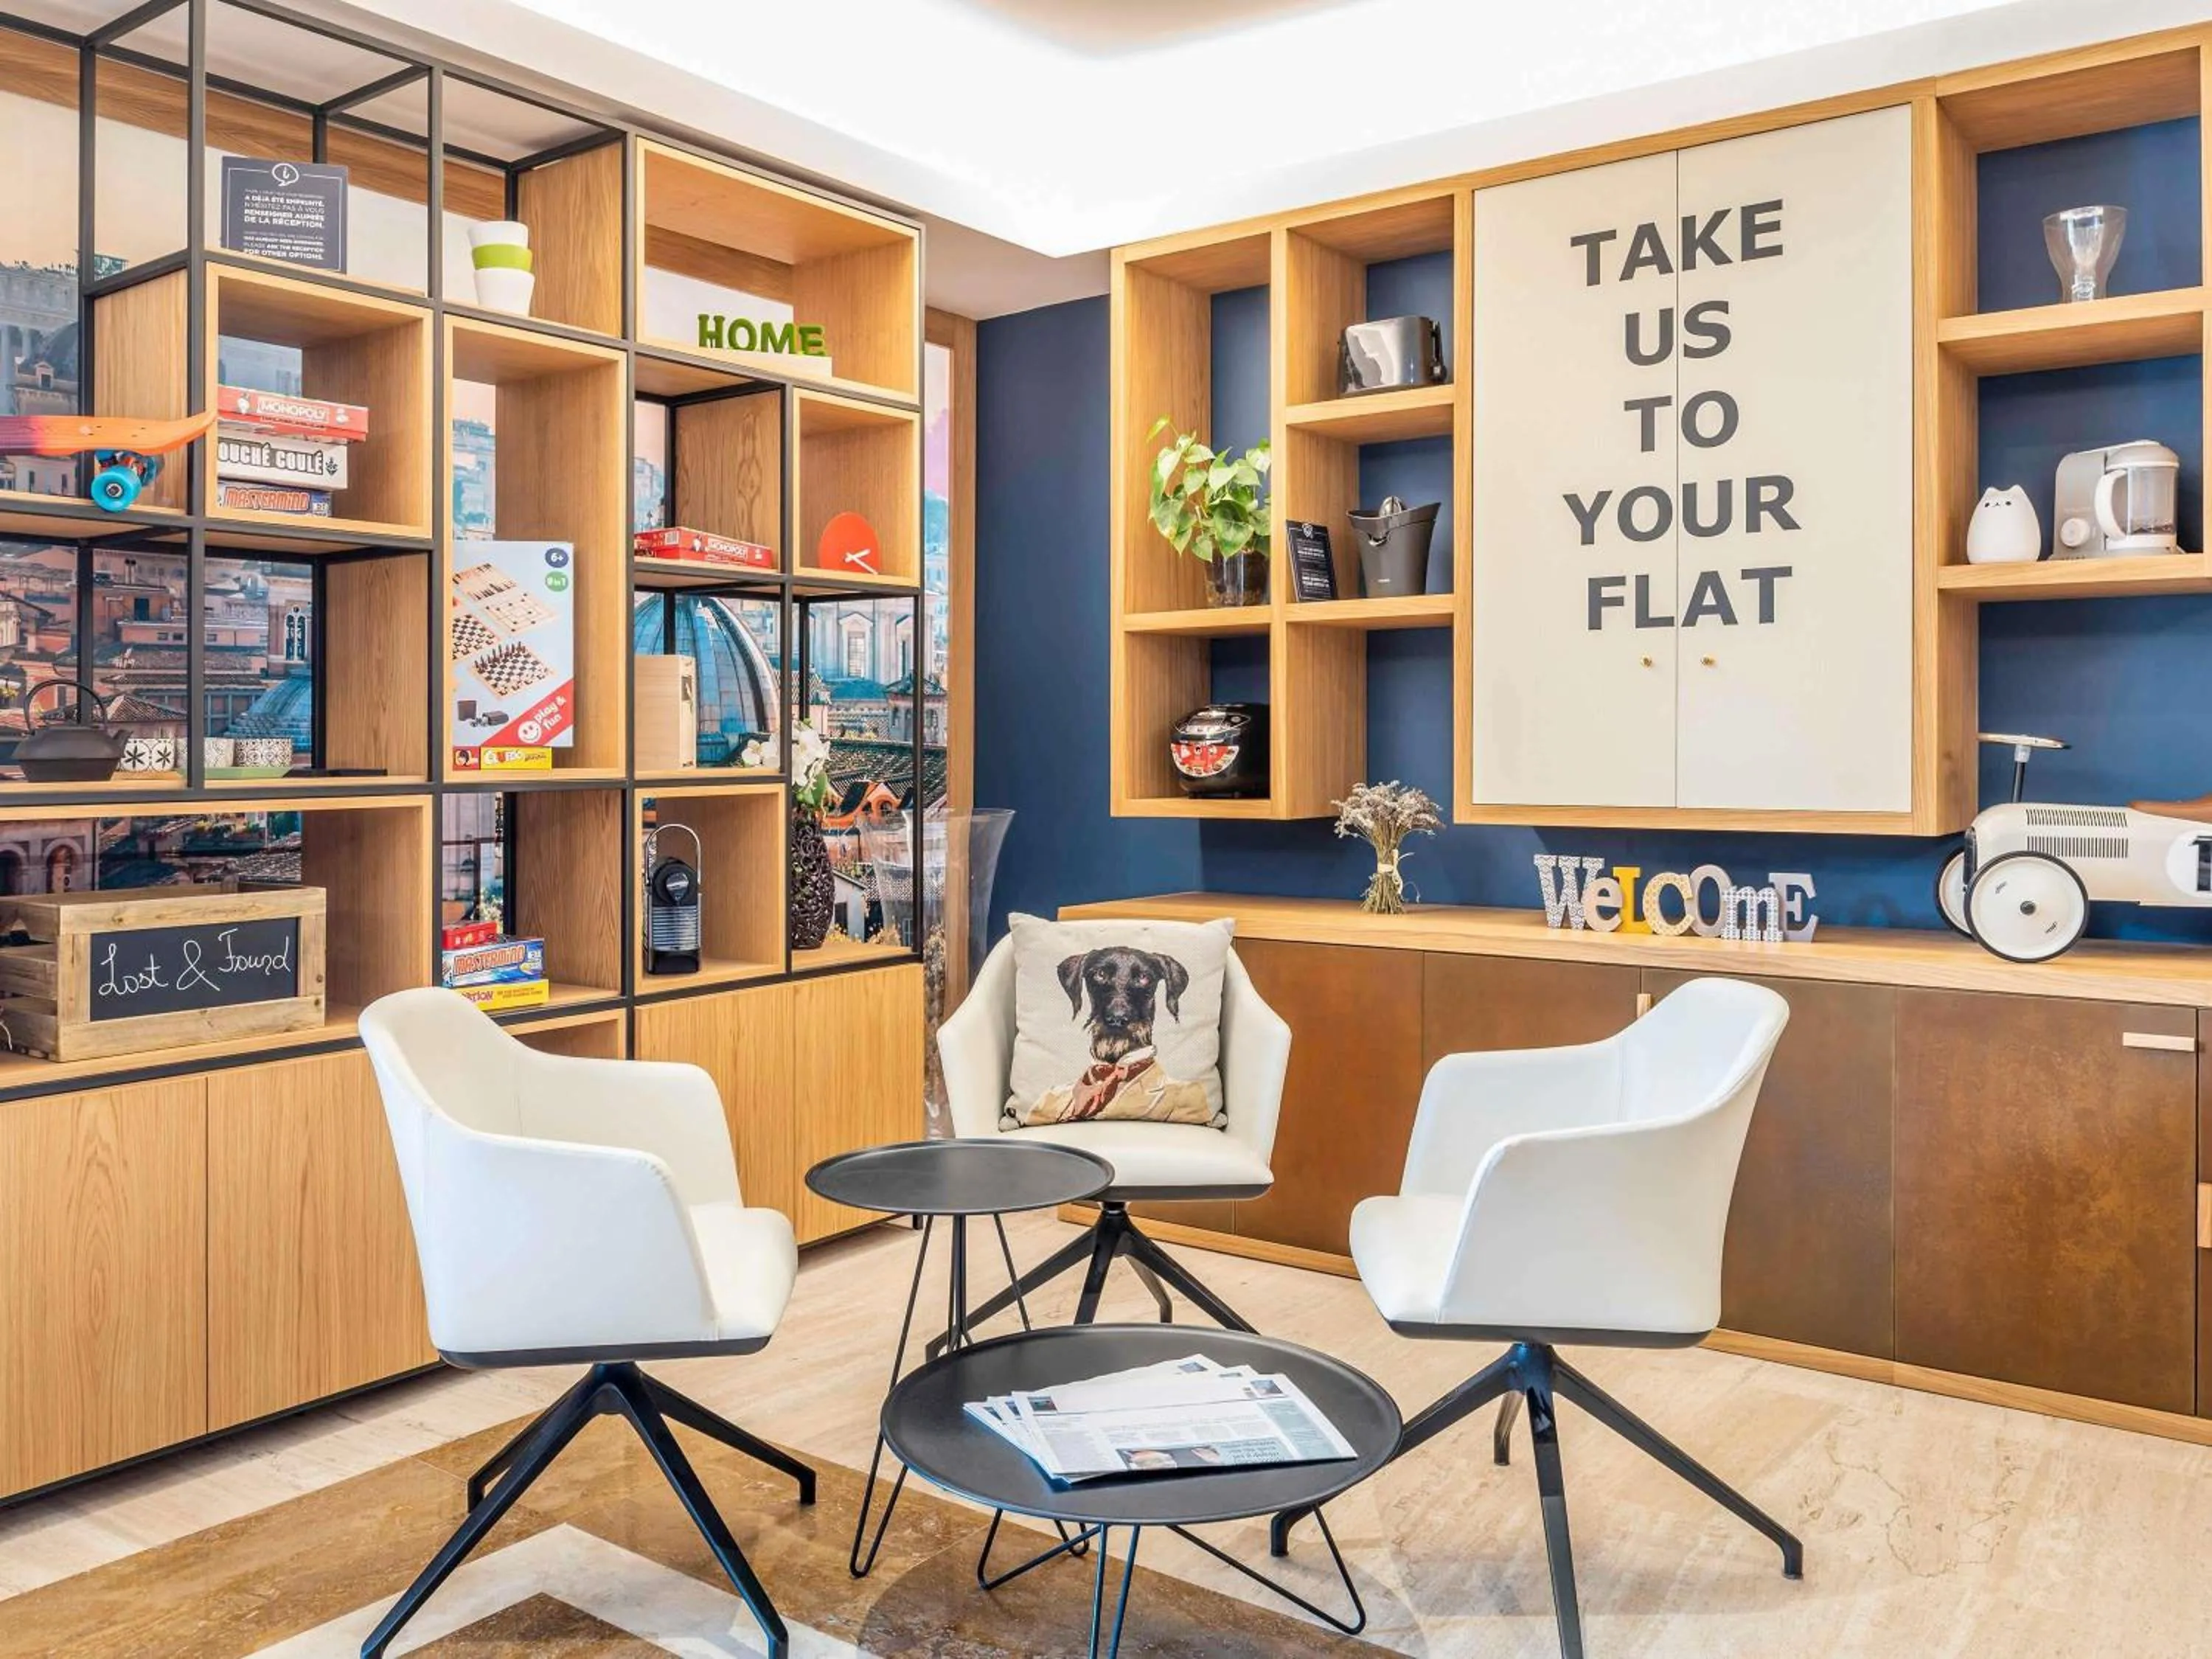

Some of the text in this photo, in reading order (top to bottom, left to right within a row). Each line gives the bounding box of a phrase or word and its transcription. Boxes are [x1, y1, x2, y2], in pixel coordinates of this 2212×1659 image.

[244, 215, 257, 223] DE
[1571, 199, 1784, 286] TAKE
[698, 314, 825, 356] HOME
[1625, 300, 1732, 366] US
[260, 401, 327, 420] MONOPOLY
[1624, 390, 1739, 452] TO
[218, 442, 323, 475] OUCHÉ COULÉ
[1563, 476, 1801, 546] YOUR
[1587, 566, 1792, 630] FLAT
[534, 702, 559, 723] play
[543, 713, 562, 730] fun
[98, 928, 291, 996] Lost & Found
